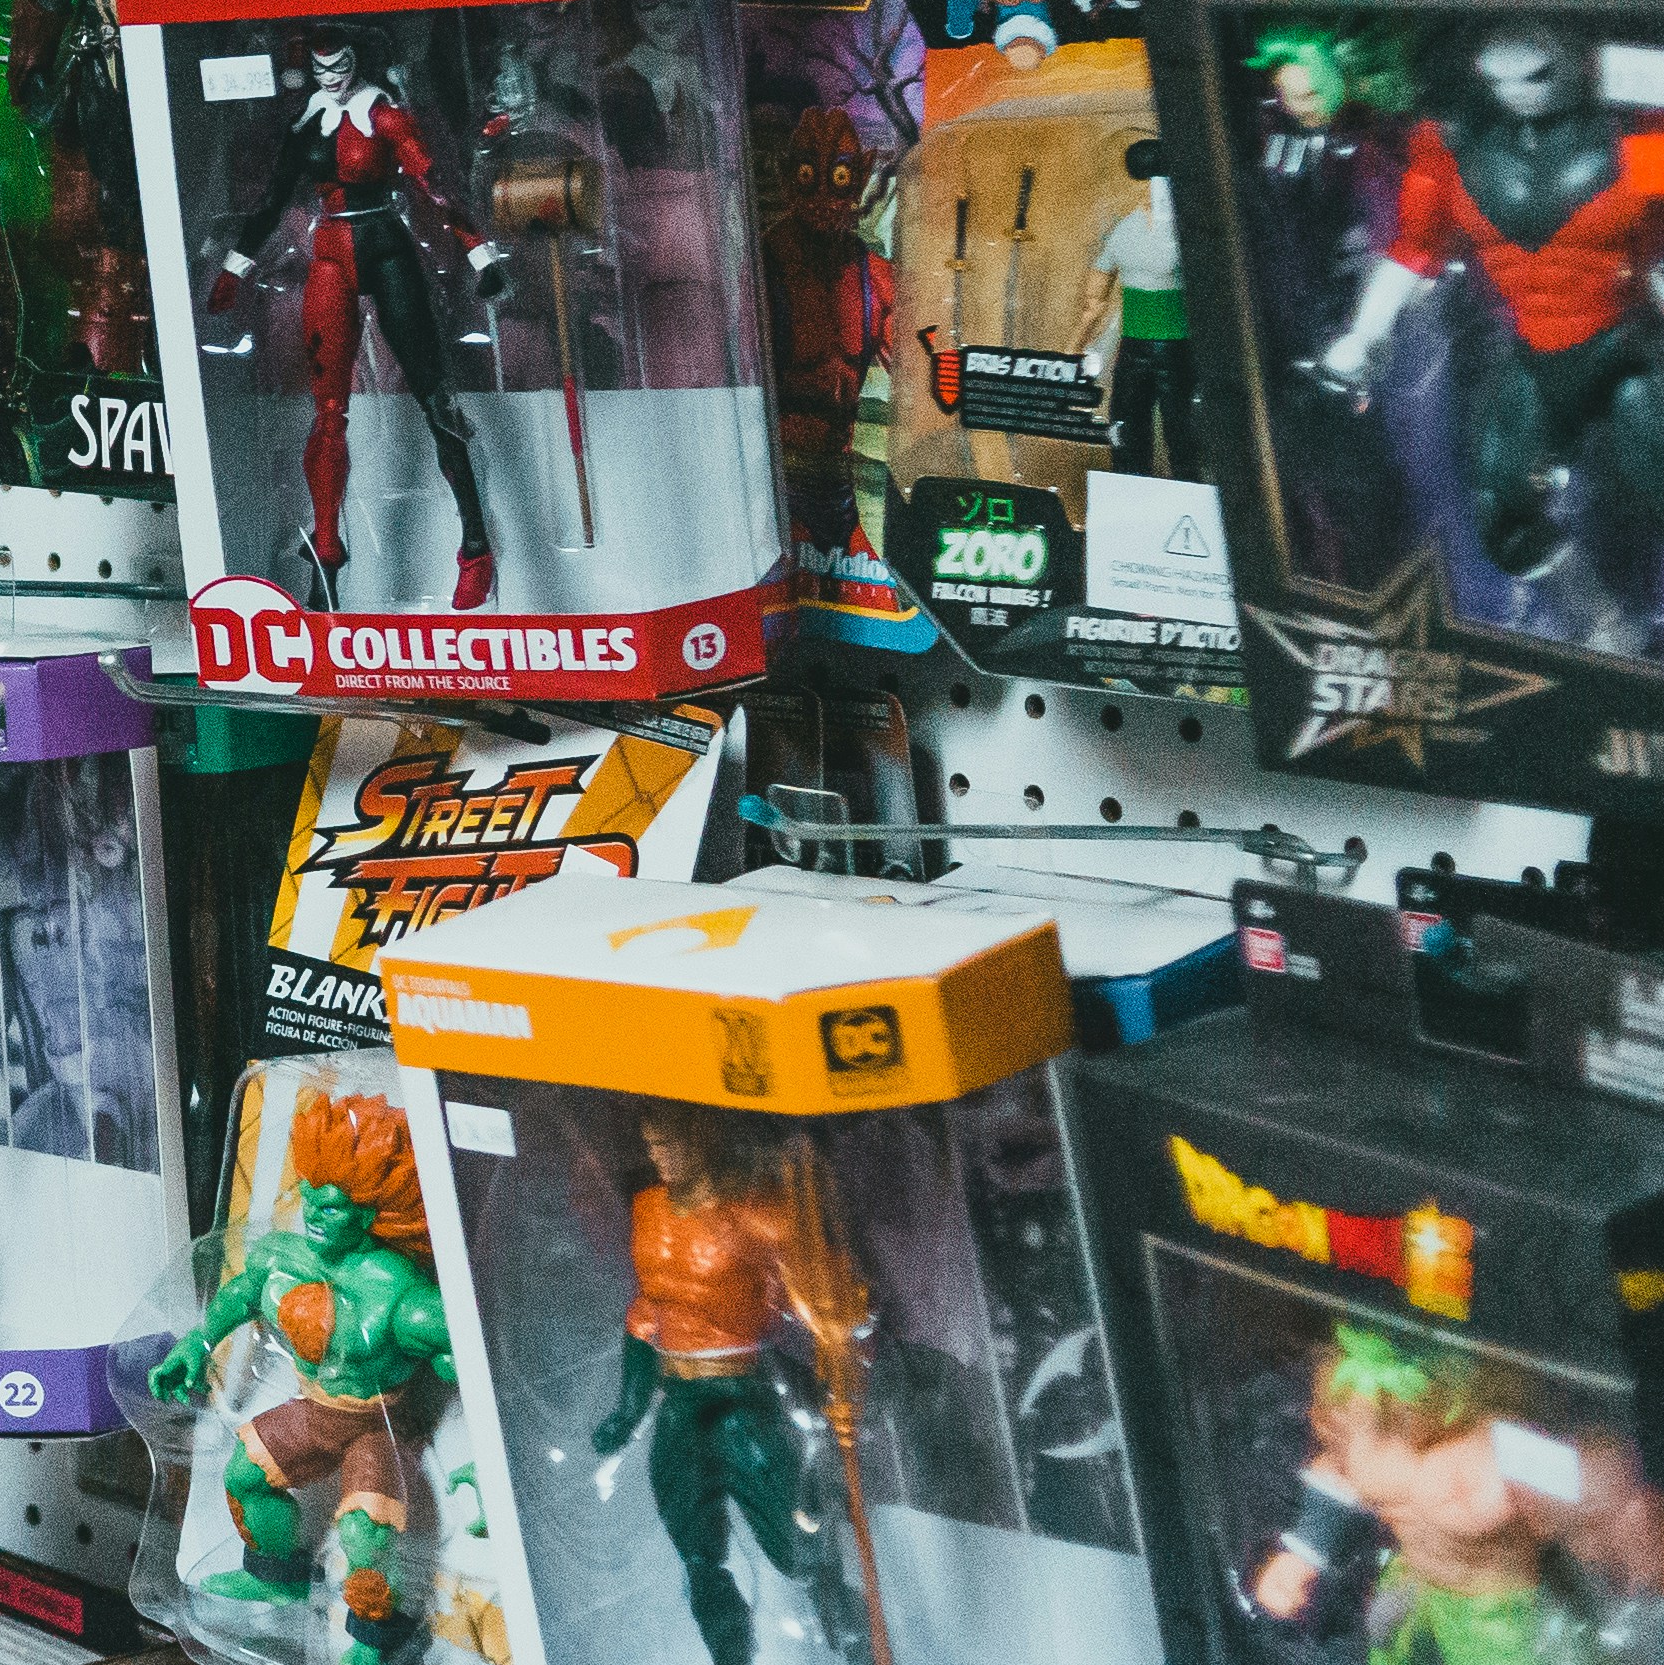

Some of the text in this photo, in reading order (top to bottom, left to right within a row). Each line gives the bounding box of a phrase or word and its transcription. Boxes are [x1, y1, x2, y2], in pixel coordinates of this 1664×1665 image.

[936, 528, 1047, 582] ZORO
[931, 581, 984, 606] FALCON
[193, 607, 638, 685] DC COLLECTIBLES
[690, 633, 720, 662] 13
[1066, 616, 1242, 650] FIGURINE D'ACTIO
[335, 674, 511, 691] DIRECT FROM THE SOURCE
[1315, 643, 1464, 683] DRAGON
[1311, 673, 1459, 722] STARS
[309, 756, 586, 864] STREET
[265, 963, 391, 1024] BLANK
[265, 1021, 300, 1041] FIGURA
[303, 1029, 316, 1043] DE
[268, 1006, 306, 1025] ACTION
[397, 991, 534, 1040] AQUAMAN
[1169, 1135, 1331, 1264] DRAGON
[4, 1382, 38, 1407] 22
